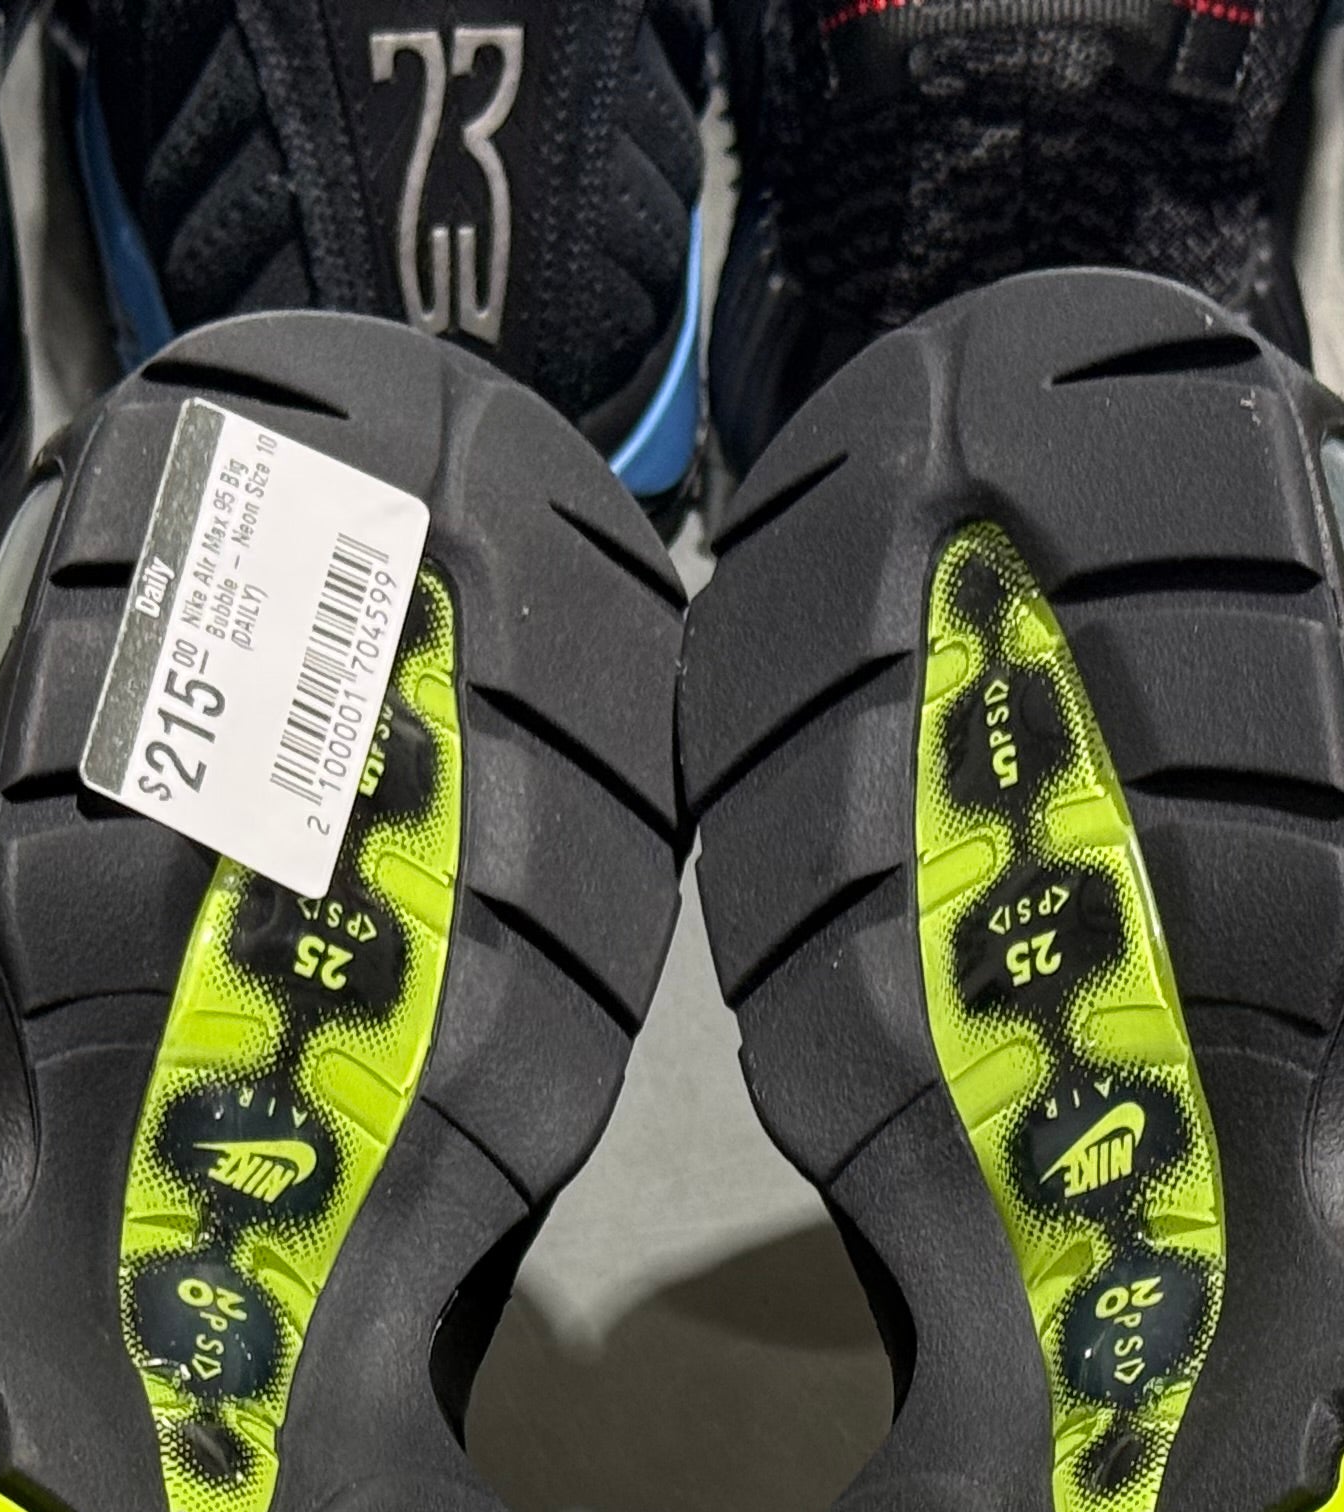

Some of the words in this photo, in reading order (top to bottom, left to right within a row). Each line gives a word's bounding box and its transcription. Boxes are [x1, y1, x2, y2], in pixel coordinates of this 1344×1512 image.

[370, 26, 524, 347] 23
[256, 433, 278, 455] 10
[219, 458, 250, 489] Big
[245, 462, 271, 498] Size
[213, 488, 236, 513] 95
[202, 516, 229, 555] Max
[231, 502, 261, 548] Neon
[135, 556, 175, 618] Daily
[193, 558, 217, 587] Air
[181, 588, 208, 628] Nike
[206, 578, 239, 640] Bubble
[231, 583, 269, 652] (DAILY)
[991, 744, 1018, 789] 5
[294, 934, 353, 990] 25
[1005, 929, 1062, 987] 25
[239, 1087, 308, 1129] AIR
[1045, 1077, 1112, 1119] AIR
[208, 1152, 295, 1203] NIKE
[1063, 1131, 1134, 1197] NIKE
[178, 1278, 248, 1321] 20
[1095, 1275, 1164, 1319] 20
